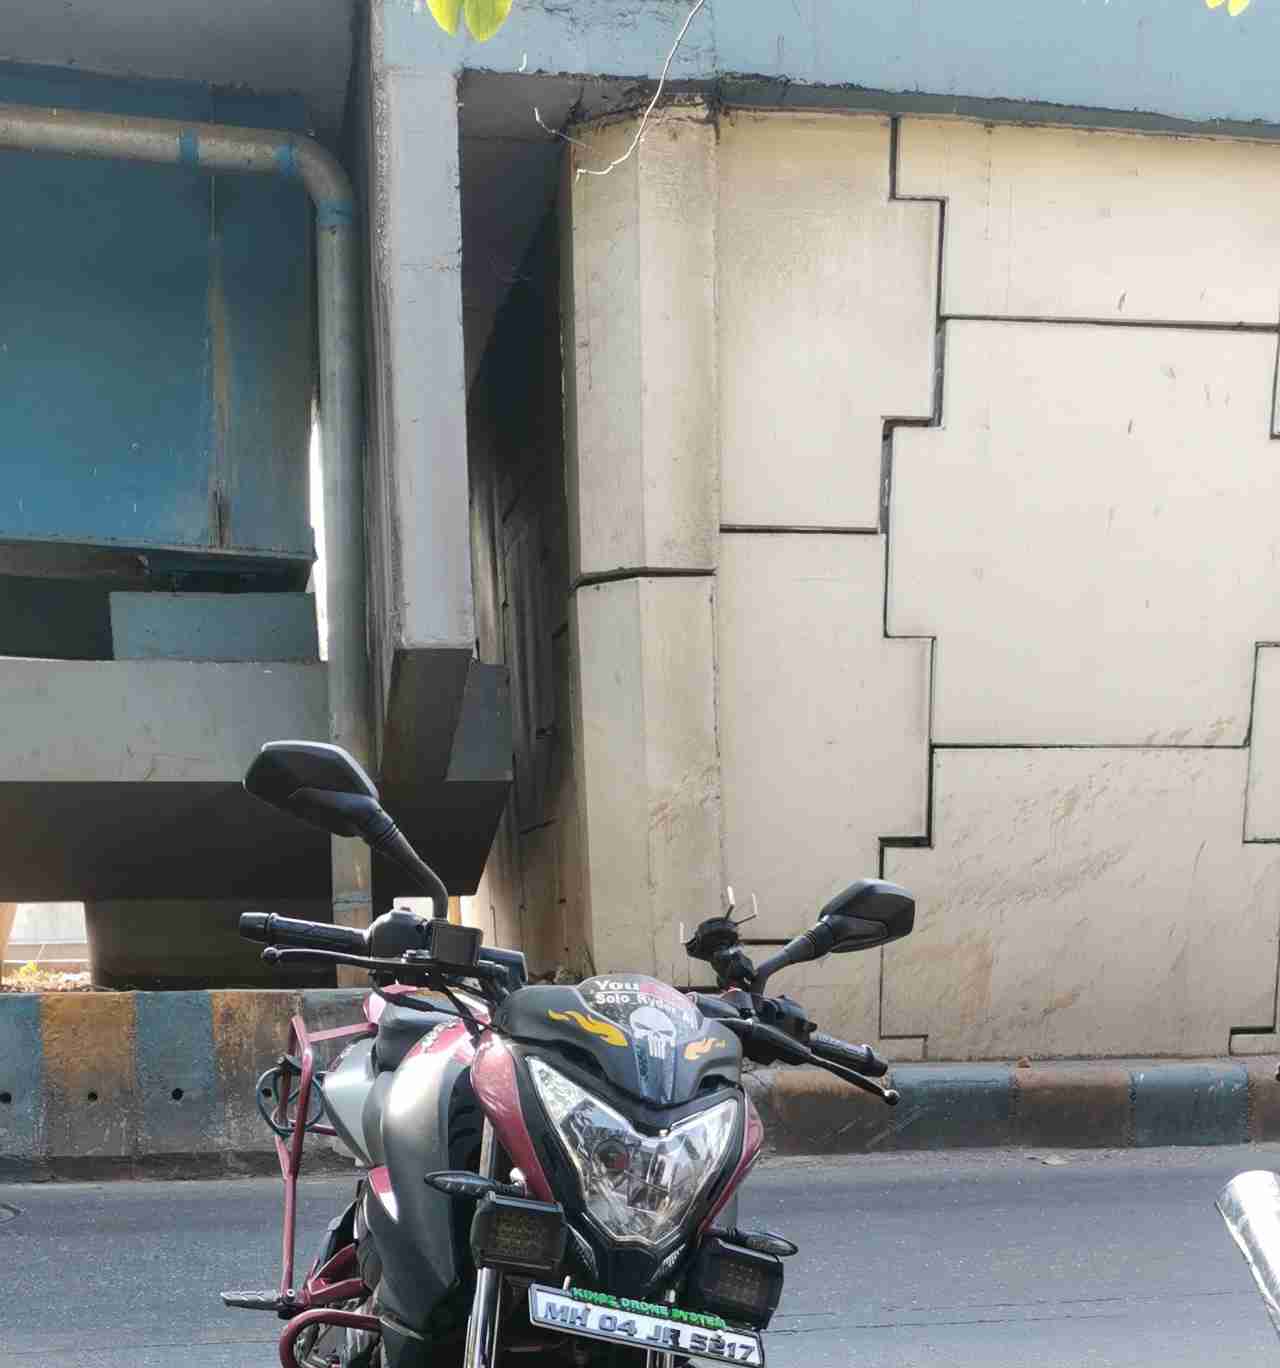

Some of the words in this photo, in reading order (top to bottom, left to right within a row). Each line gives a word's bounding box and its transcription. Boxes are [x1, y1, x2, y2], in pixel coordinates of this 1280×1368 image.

[544, 1301, 590, 1328] MH
[599, 1313, 637, 1337] 04
[646, 1324, 681, 1348] JR
